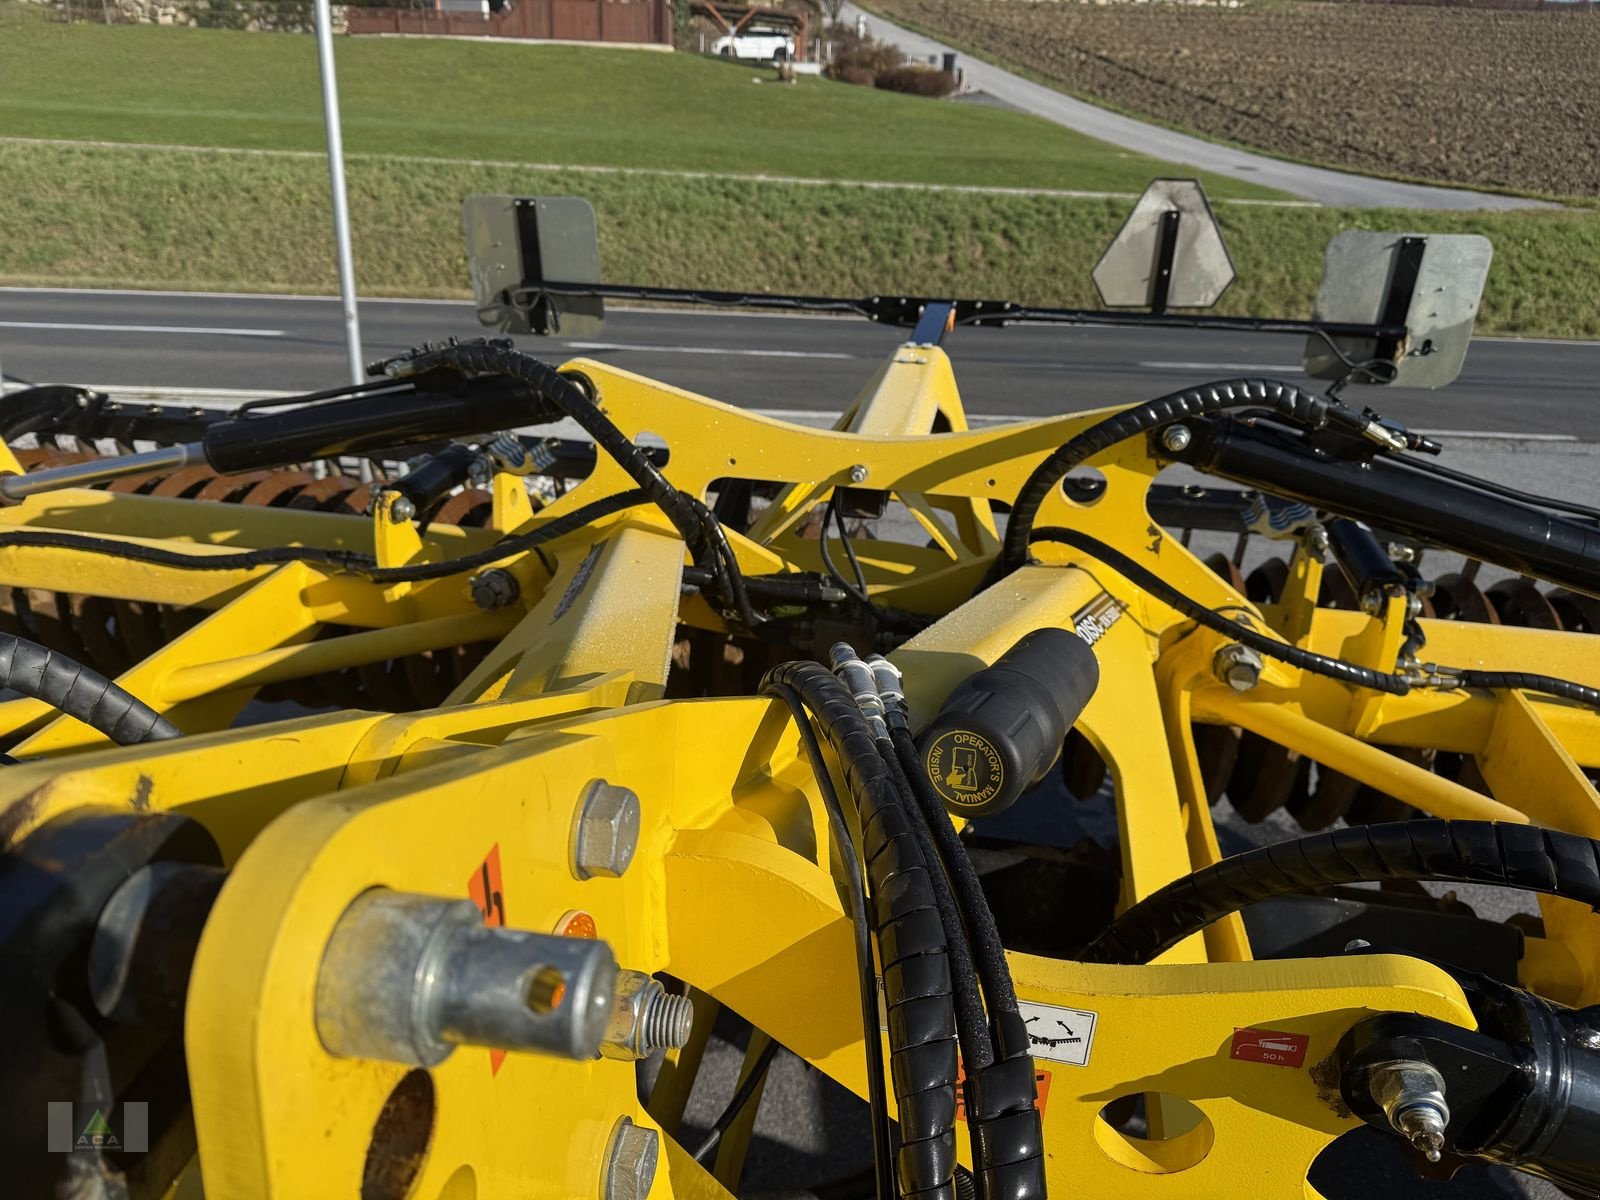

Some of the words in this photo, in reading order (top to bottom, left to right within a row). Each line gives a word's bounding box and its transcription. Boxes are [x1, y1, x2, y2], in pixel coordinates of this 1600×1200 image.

[931, 746, 944, 783] INSIDE
[954, 734, 1000, 782] OPERATOR'S
[954, 784, 995, 803] MANUAL
[1263, 1052, 1277, 1060] 50
